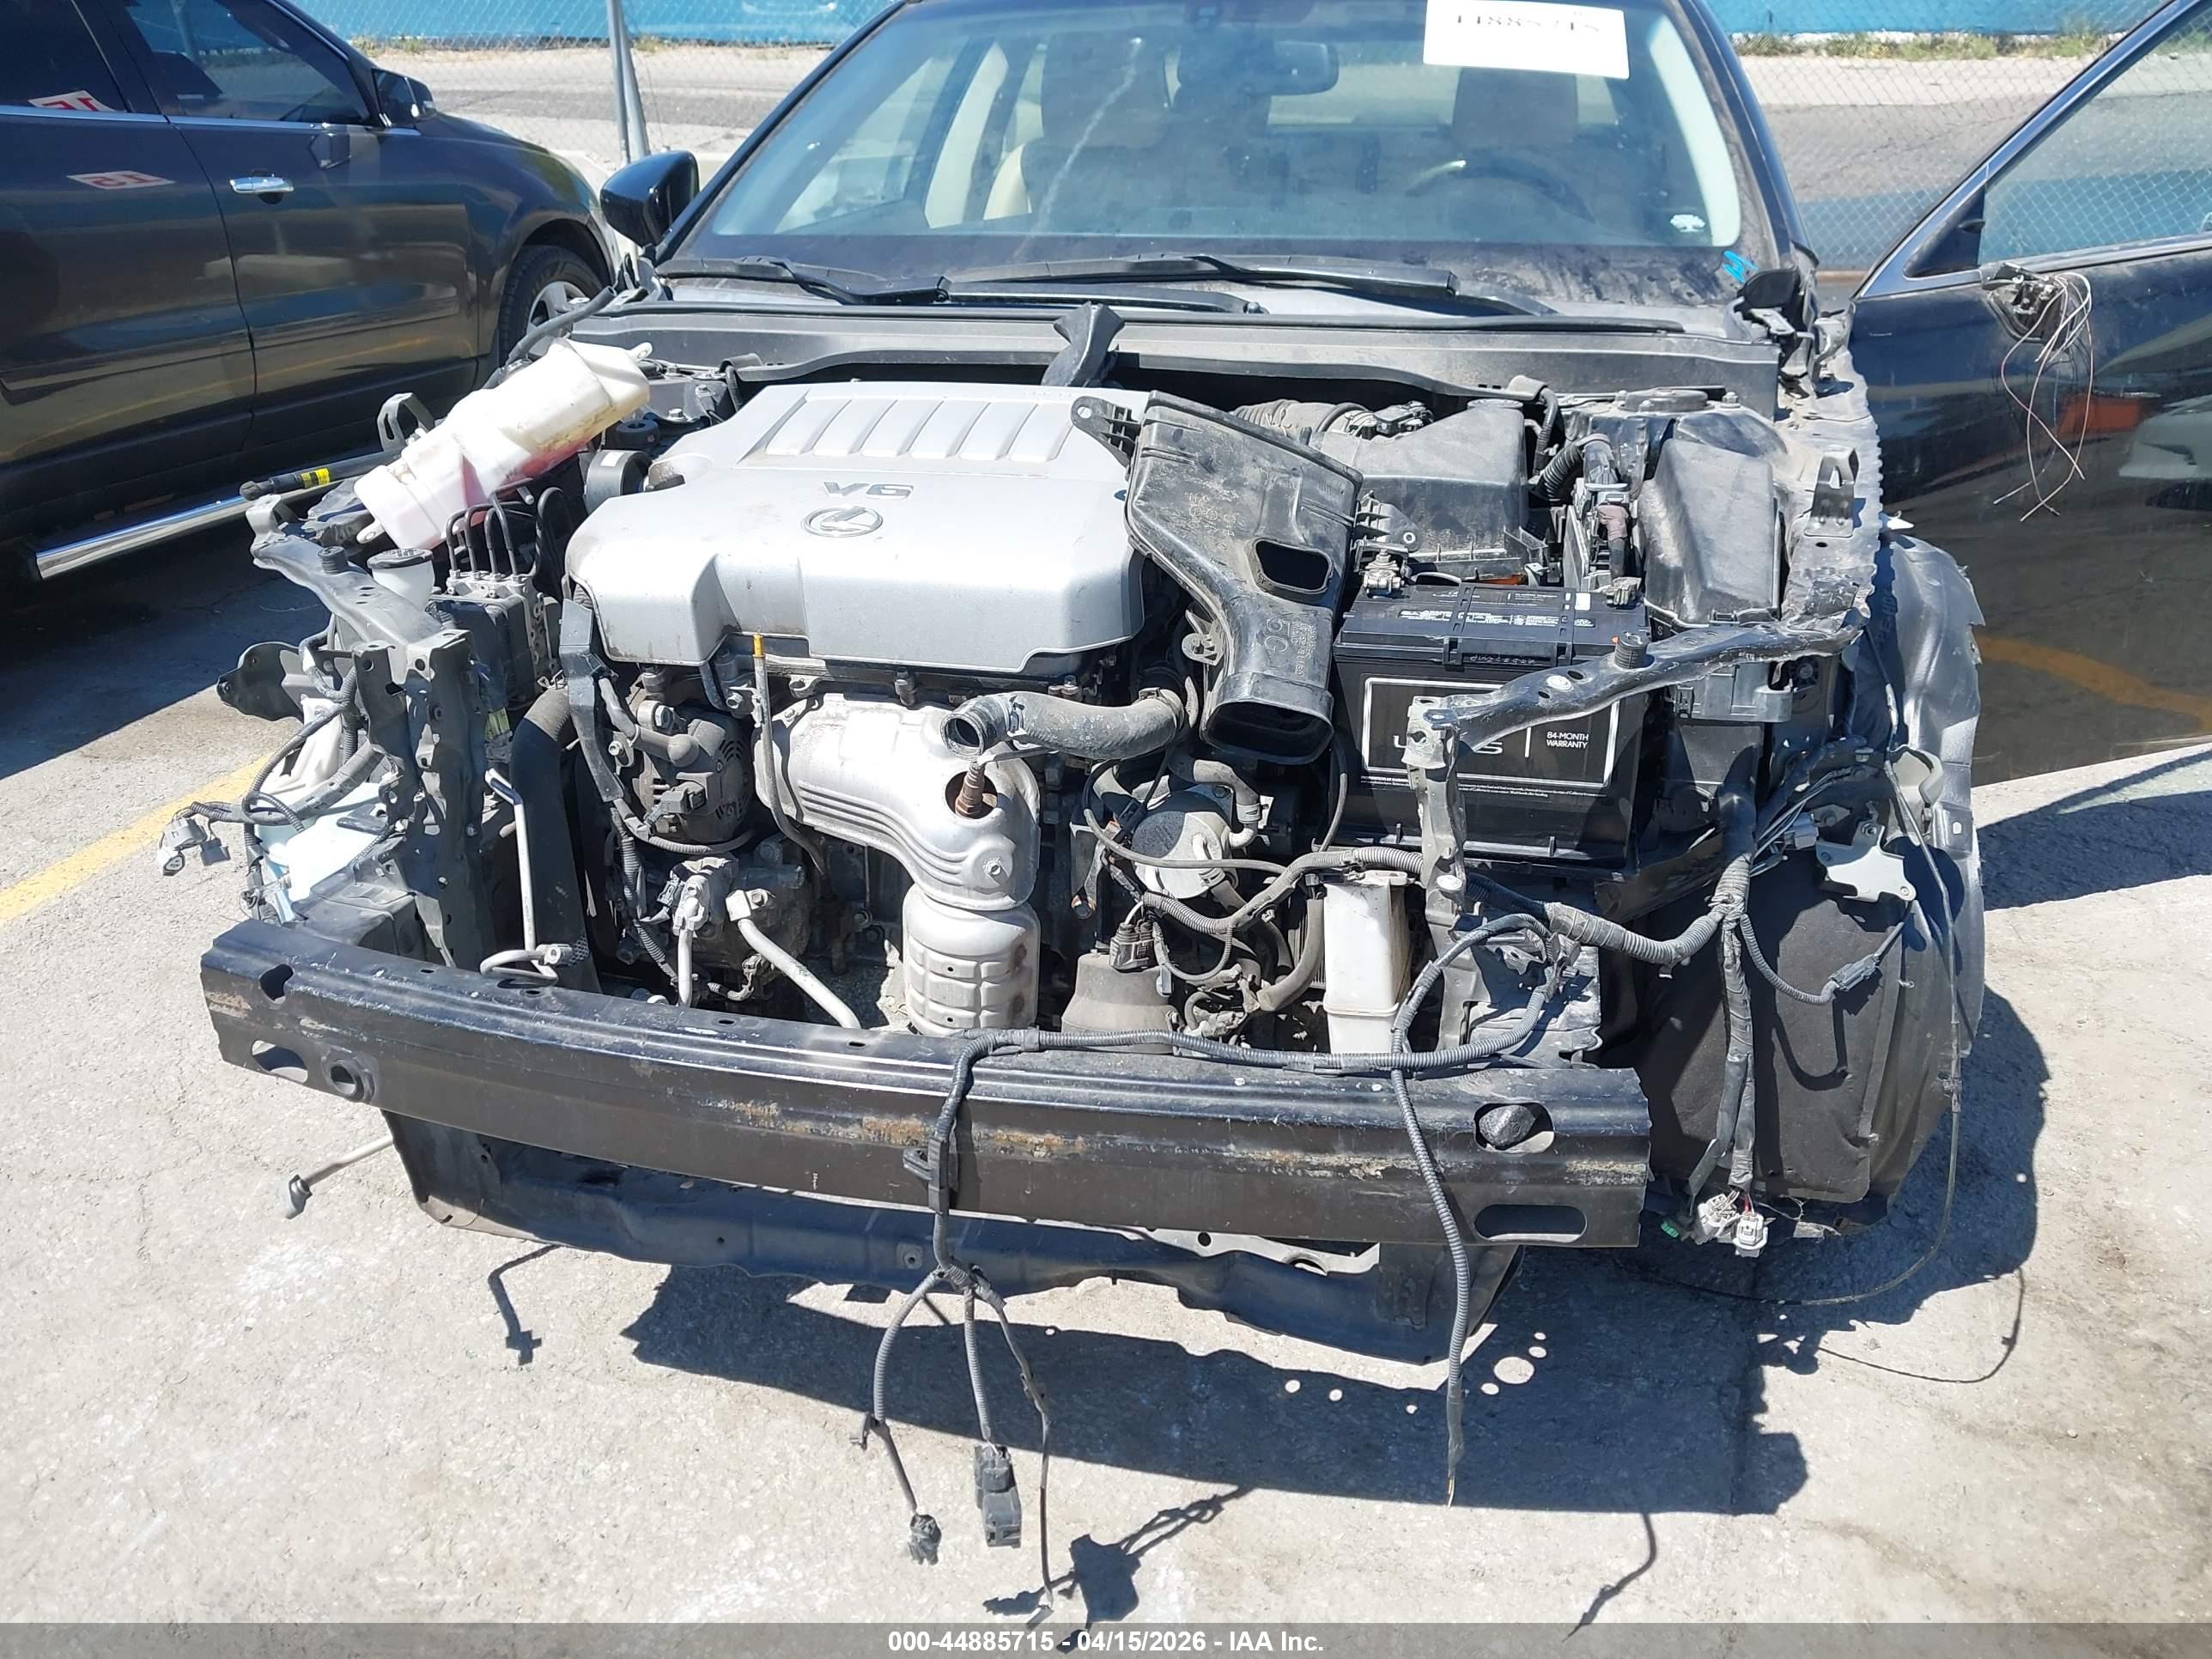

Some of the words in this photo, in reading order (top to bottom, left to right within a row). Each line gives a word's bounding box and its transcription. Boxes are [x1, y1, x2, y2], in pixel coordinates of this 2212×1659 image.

[823, 482, 914, 498] V6
[1547, 731, 1589, 741] 84-MONTH
[1547, 738, 1589, 749] WARRANTY
